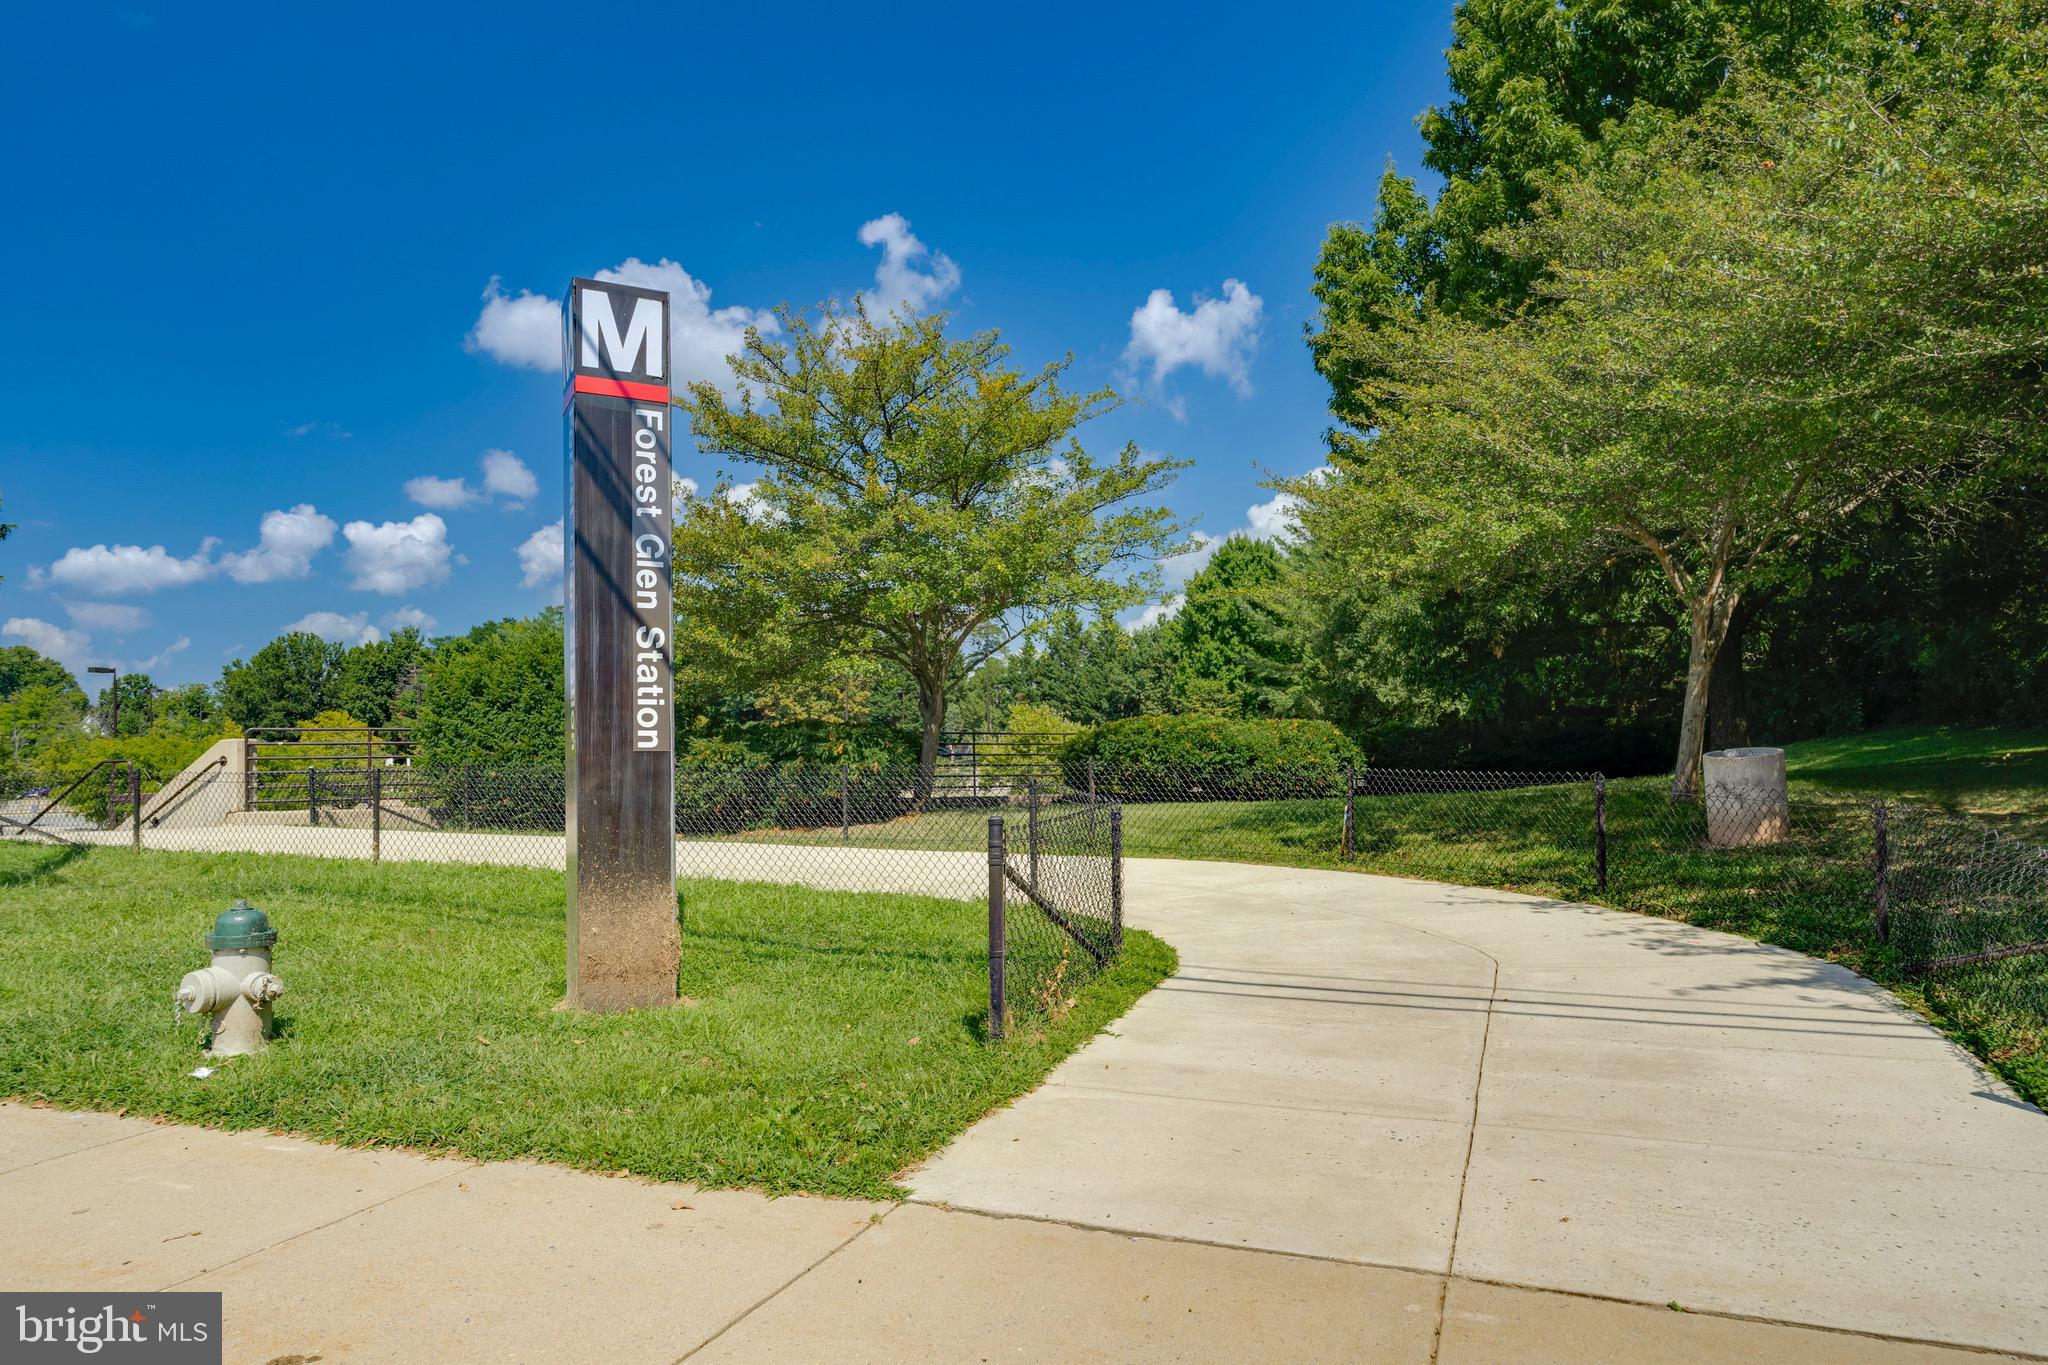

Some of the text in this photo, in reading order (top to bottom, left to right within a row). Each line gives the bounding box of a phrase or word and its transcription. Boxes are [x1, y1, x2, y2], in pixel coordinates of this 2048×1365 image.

[582, 288, 663, 379] M
[635, 408, 666, 749] Forest Glen Station
